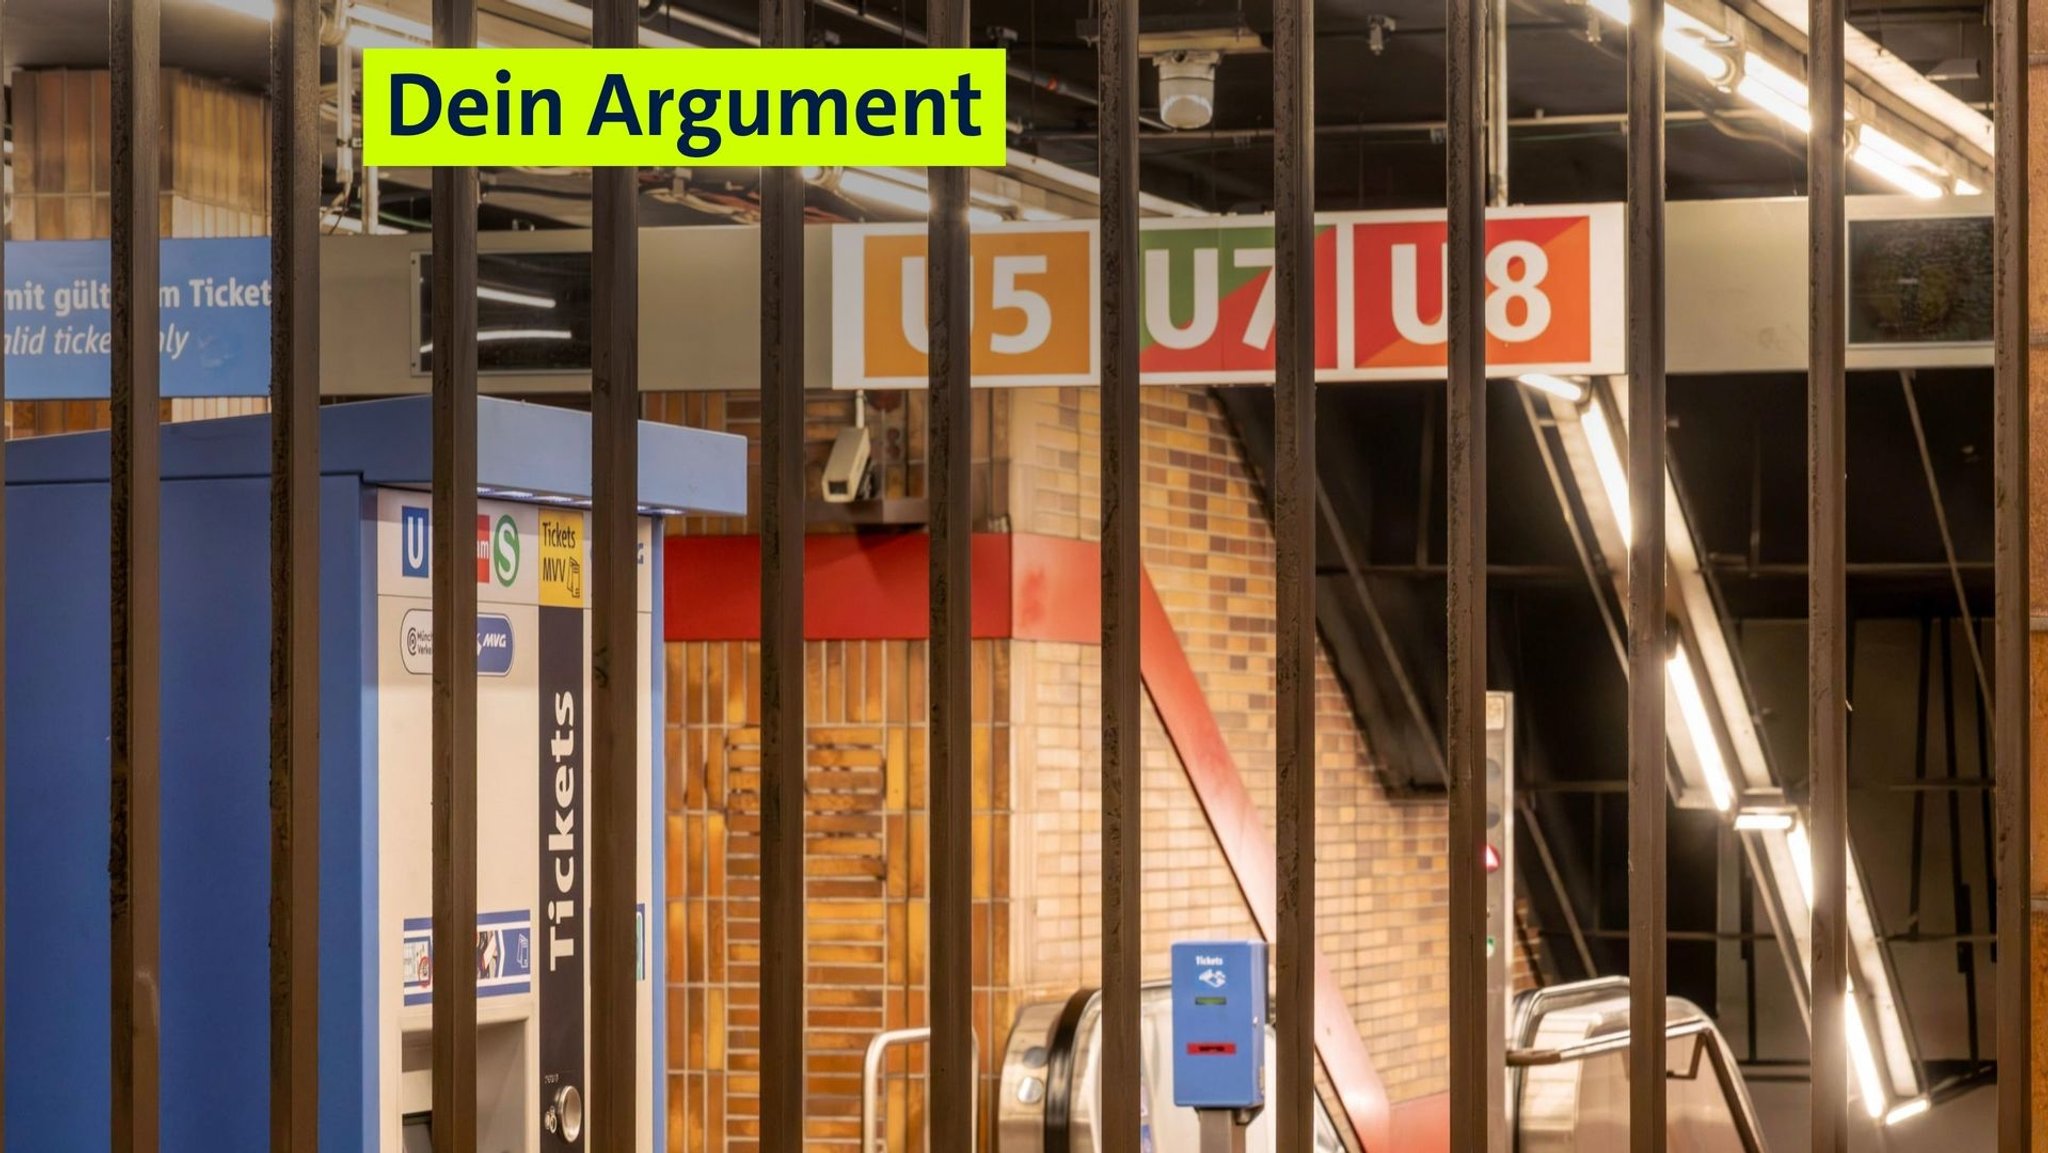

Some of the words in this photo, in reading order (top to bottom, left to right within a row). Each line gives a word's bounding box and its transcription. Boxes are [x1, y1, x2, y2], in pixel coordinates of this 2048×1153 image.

[189, 277, 271, 307] Ticket
[1145, 248, 1275, 350] U7
[1391, 240, 1551, 345] U8
[54, 324, 111, 354] ticke
[408, 516, 424, 569] U
[542, 521, 576, 549] Tickets
[498, 522, 516, 581] S
[542, 556, 566, 582] MVV
[483, 632, 506, 648] MVG
[548, 690, 574, 972] Tickets
[1195, 955, 1223, 966] Tickets
